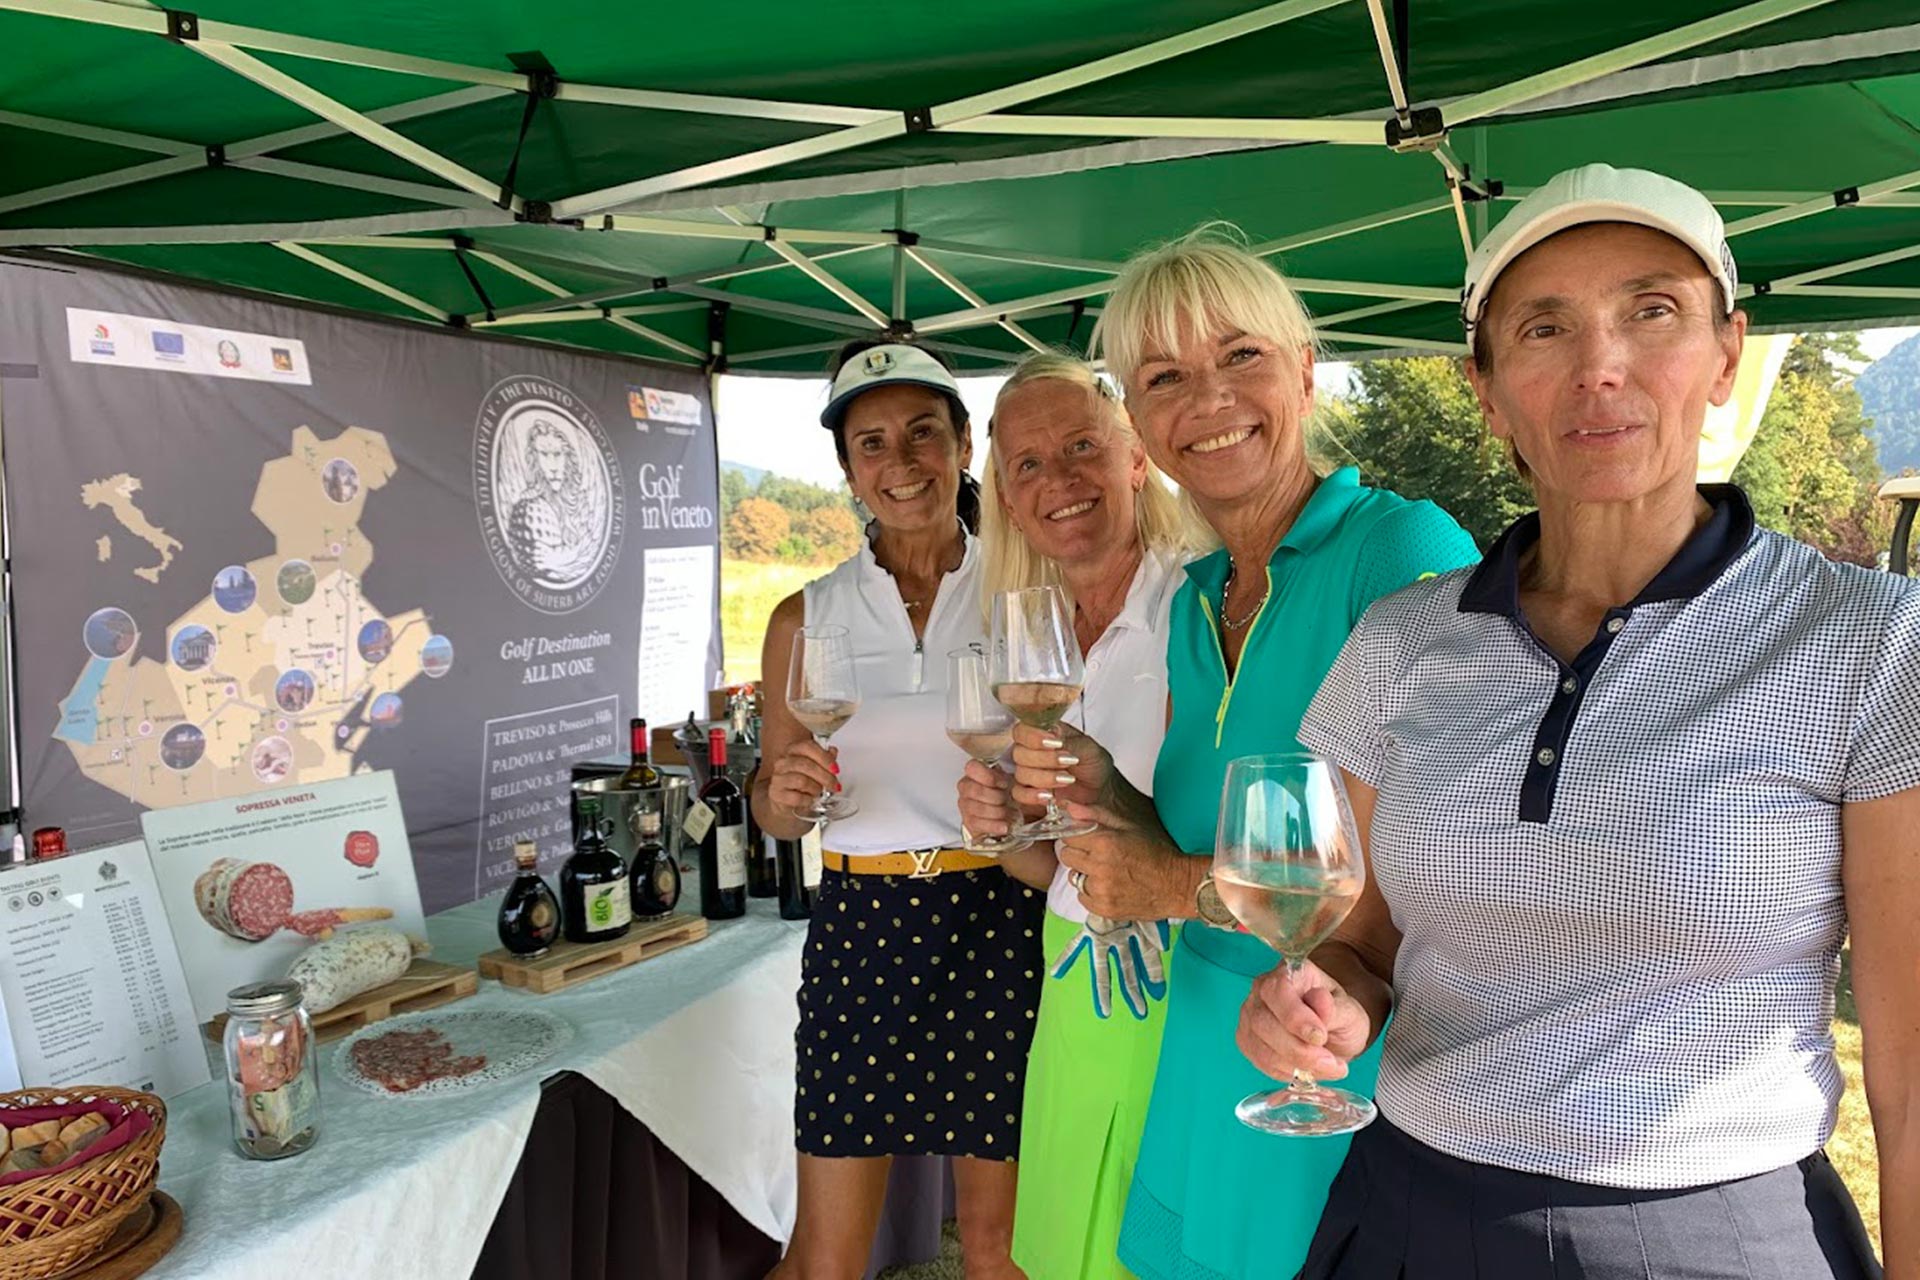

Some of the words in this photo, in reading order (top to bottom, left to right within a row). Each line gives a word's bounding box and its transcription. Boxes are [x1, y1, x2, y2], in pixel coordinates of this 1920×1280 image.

[499, 383, 523, 402] THE
[522, 382, 573, 407] VENETO
[639, 463, 684, 499] Golf
[483, 515, 516, 580] REGION
[515, 578, 532, 597] OF
[532, 590, 573, 609] SUPERB
[501, 637, 536, 662] Golf
[536, 630, 612, 656] Destination
[522, 664, 549, 684] ALL
[551, 661, 566, 680] IN
[568, 657, 595, 677] ONE
[493, 724, 546, 746] TREVISO
[547, 722, 557, 736] &
[559, 717, 595, 733] Prosecco
[595, 709, 613, 725] Hills
[492, 751, 543, 774] PADOVA
[545, 749, 556, 761] &
[559, 738, 594, 758] Thermal
[594, 733, 612, 749] SPA
[490, 776, 541, 800] BELLUNO
[543, 774, 554, 787] &
[235, 799, 281, 814] SOPRESSA
[282, 792, 317, 806] VENETA
[488, 801, 541, 828] ROVIGO
[541, 800, 553, 812] &
[487, 827, 538, 853] VERONA
[540, 824, 551, 838] &
[486, 858, 517, 878] VICE
[594, 899, 609, 921] BIO
